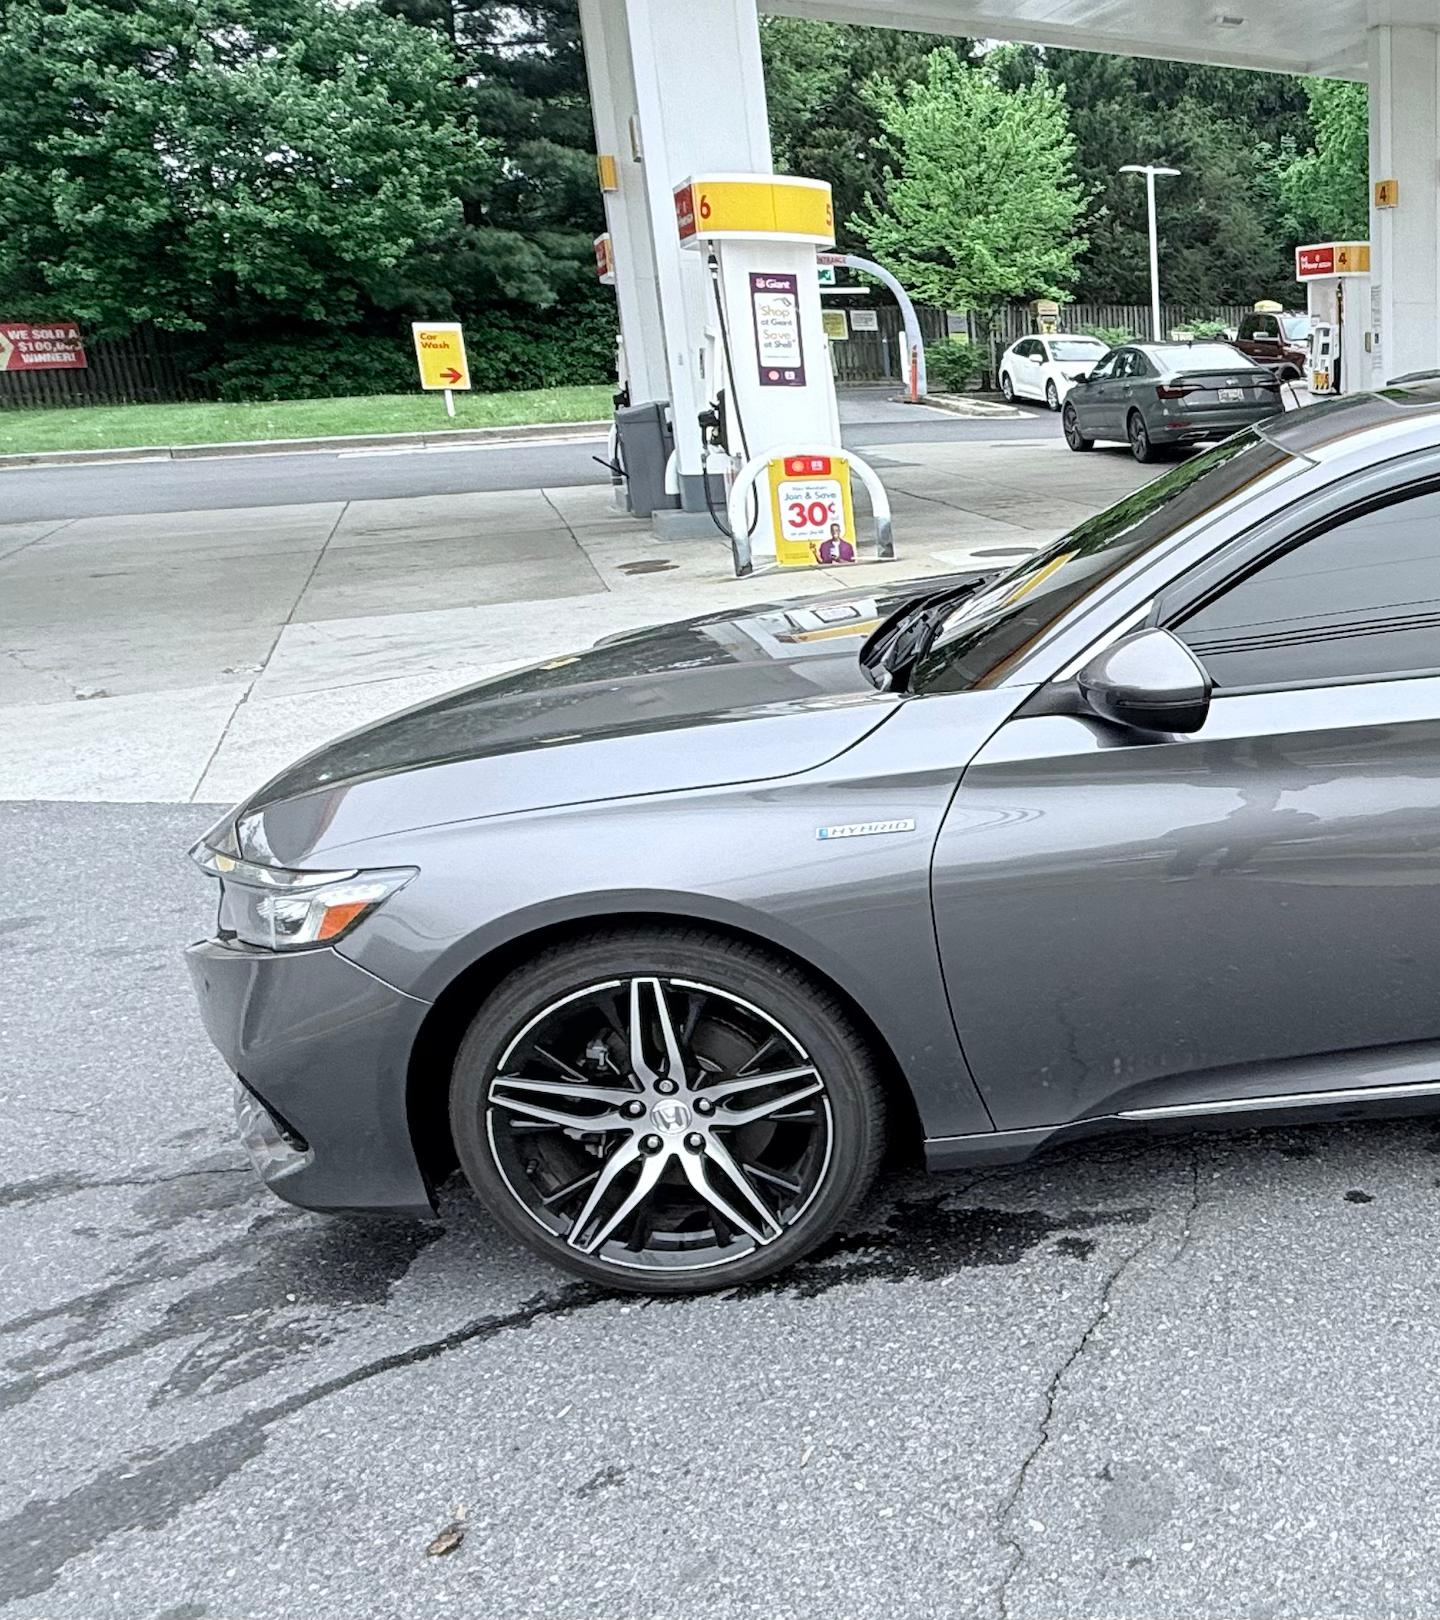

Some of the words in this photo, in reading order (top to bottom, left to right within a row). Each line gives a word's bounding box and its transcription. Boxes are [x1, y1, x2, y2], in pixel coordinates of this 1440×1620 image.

[1379, 185, 1388, 202] 4
[700, 194, 711, 220] 6
[825, 203, 832, 226] 5
[1338, 251, 1348, 265] 4
[766, 279, 791, 289] Giant
[761, 305, 791, 318] Shop
[8, 329, 30, 340] WE
[32, 328, 66, 340] SOLD
[68, 328, 79, 339] A
[420, 332, 437, 340] Car
[763, 329, 791, 340] Save
[420, 340, 449, 350] Wash
[21, 351, 77, 363] WINNER!
[785, 493, 803, 501] Join
[804, 491, 812, 500] &
[814, 490, 836, 500] Save
[788, 502, 835, 528] 30¢
[832, 822, 908, 836] HYBRID
